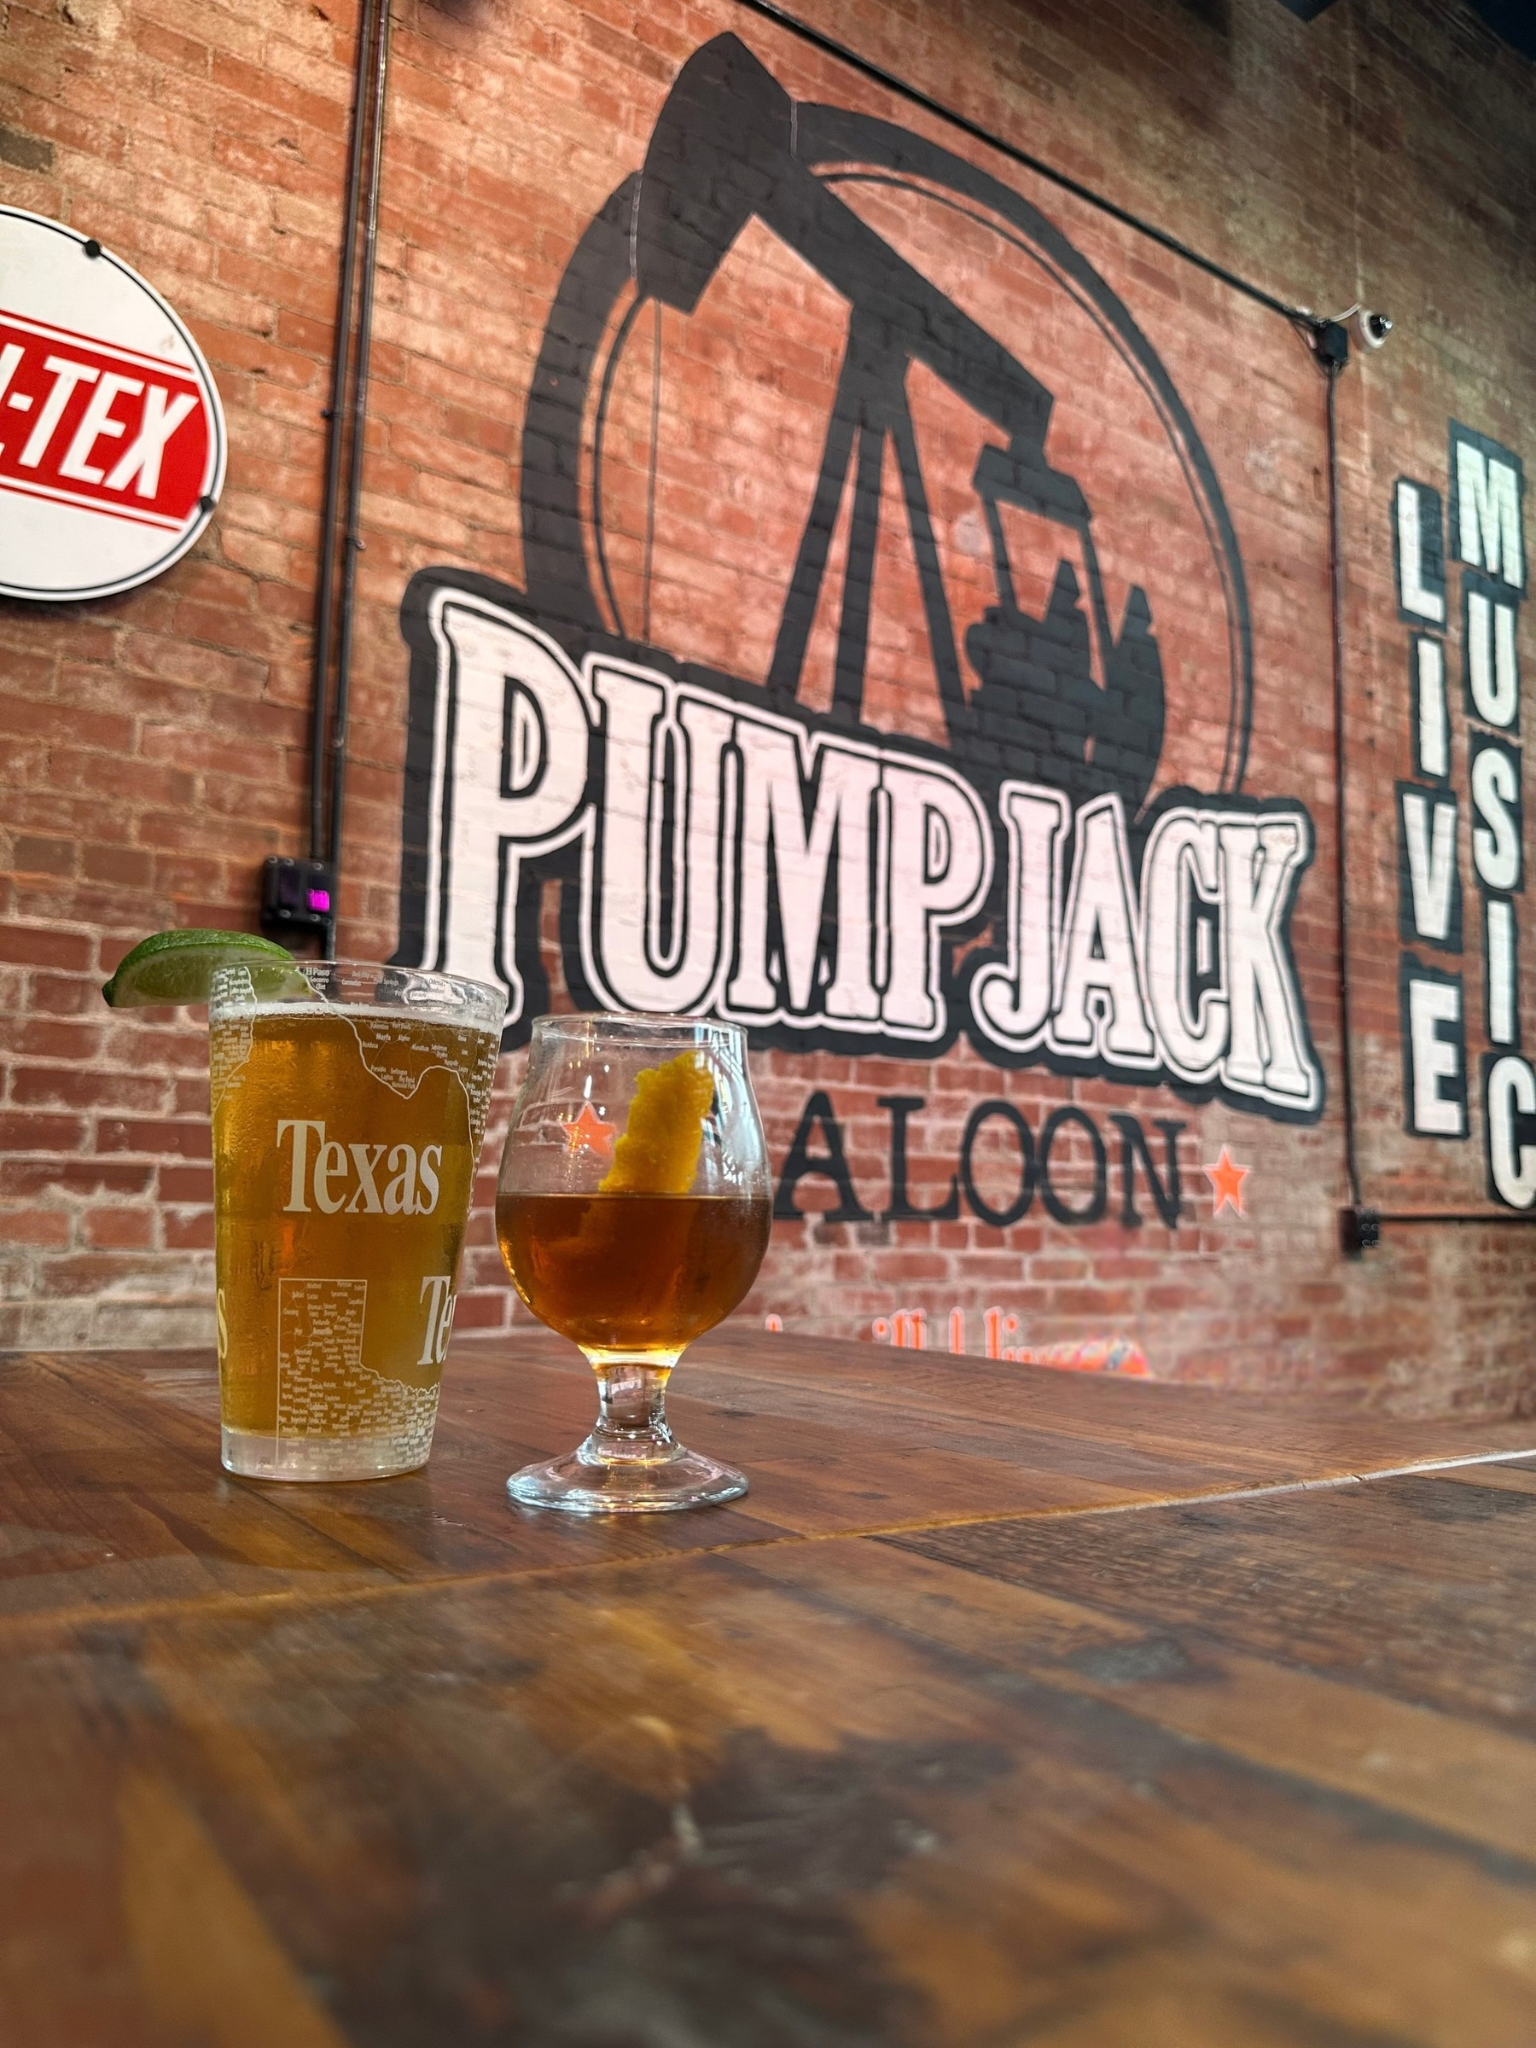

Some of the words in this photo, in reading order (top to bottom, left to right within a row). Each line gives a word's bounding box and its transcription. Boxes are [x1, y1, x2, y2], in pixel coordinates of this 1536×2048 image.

[1396, 480, 1462, 1135] LIVE
[1456, 440, 1536, 1209] MUSIC
[313, 967, 330, 977] Paso
[276, 1119, 443, 1216] Texas
[772, 1090, 1188, 1229] ALOON
